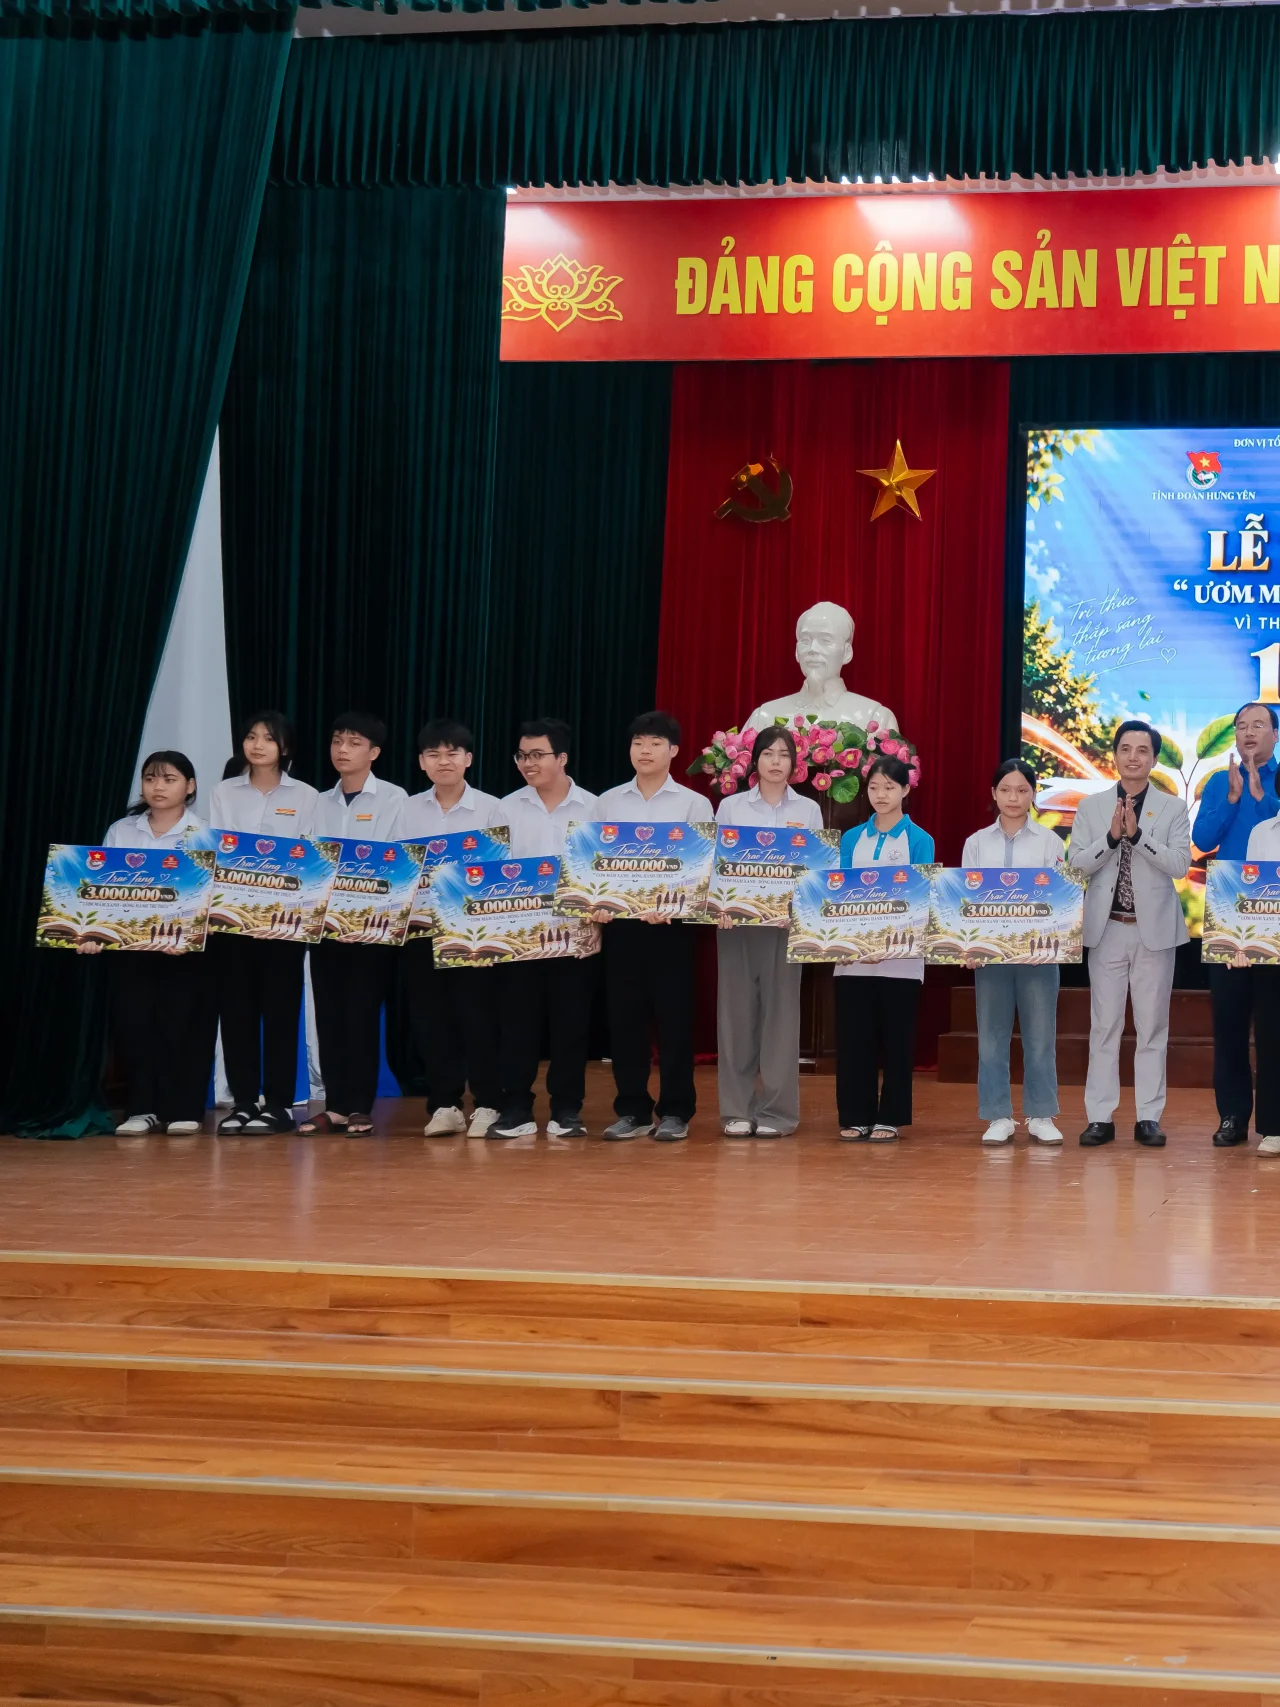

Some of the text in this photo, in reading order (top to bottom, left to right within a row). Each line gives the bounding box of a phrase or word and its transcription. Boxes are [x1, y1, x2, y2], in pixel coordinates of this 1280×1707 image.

[674, 236, 814, 315] ĐẢNG
[831, 241, 972, 326] CỘNG
[990, 229, 1100, 310] SẢN
[1116, 233, 1227, 321] VIỆT
[1234, 438, 1257, 448] ĐƠN
[1258, 438, 1267, 449] VỊ
[1152, 489, 1256, 500] TỈNH ĐOÀN HƯNG YÊN
[1207, 513, 1270, 571] LỄ
[1068, 598, 1096, 626] Tri
[1234, 614, 1251, 629] VÌ
[598, 858, 666, 870] 3.000.000
[724, 864, 792, 878] 3.000.000
[215, 868, 285, 888] 3.000.000
[85, 886, 160, 900] 3.000.000
[471, 897, 542, 914] 3.000.000
[827, 902, 892, 917] 3.000.000
[966, 904, 1036, 916] 3.000.000
